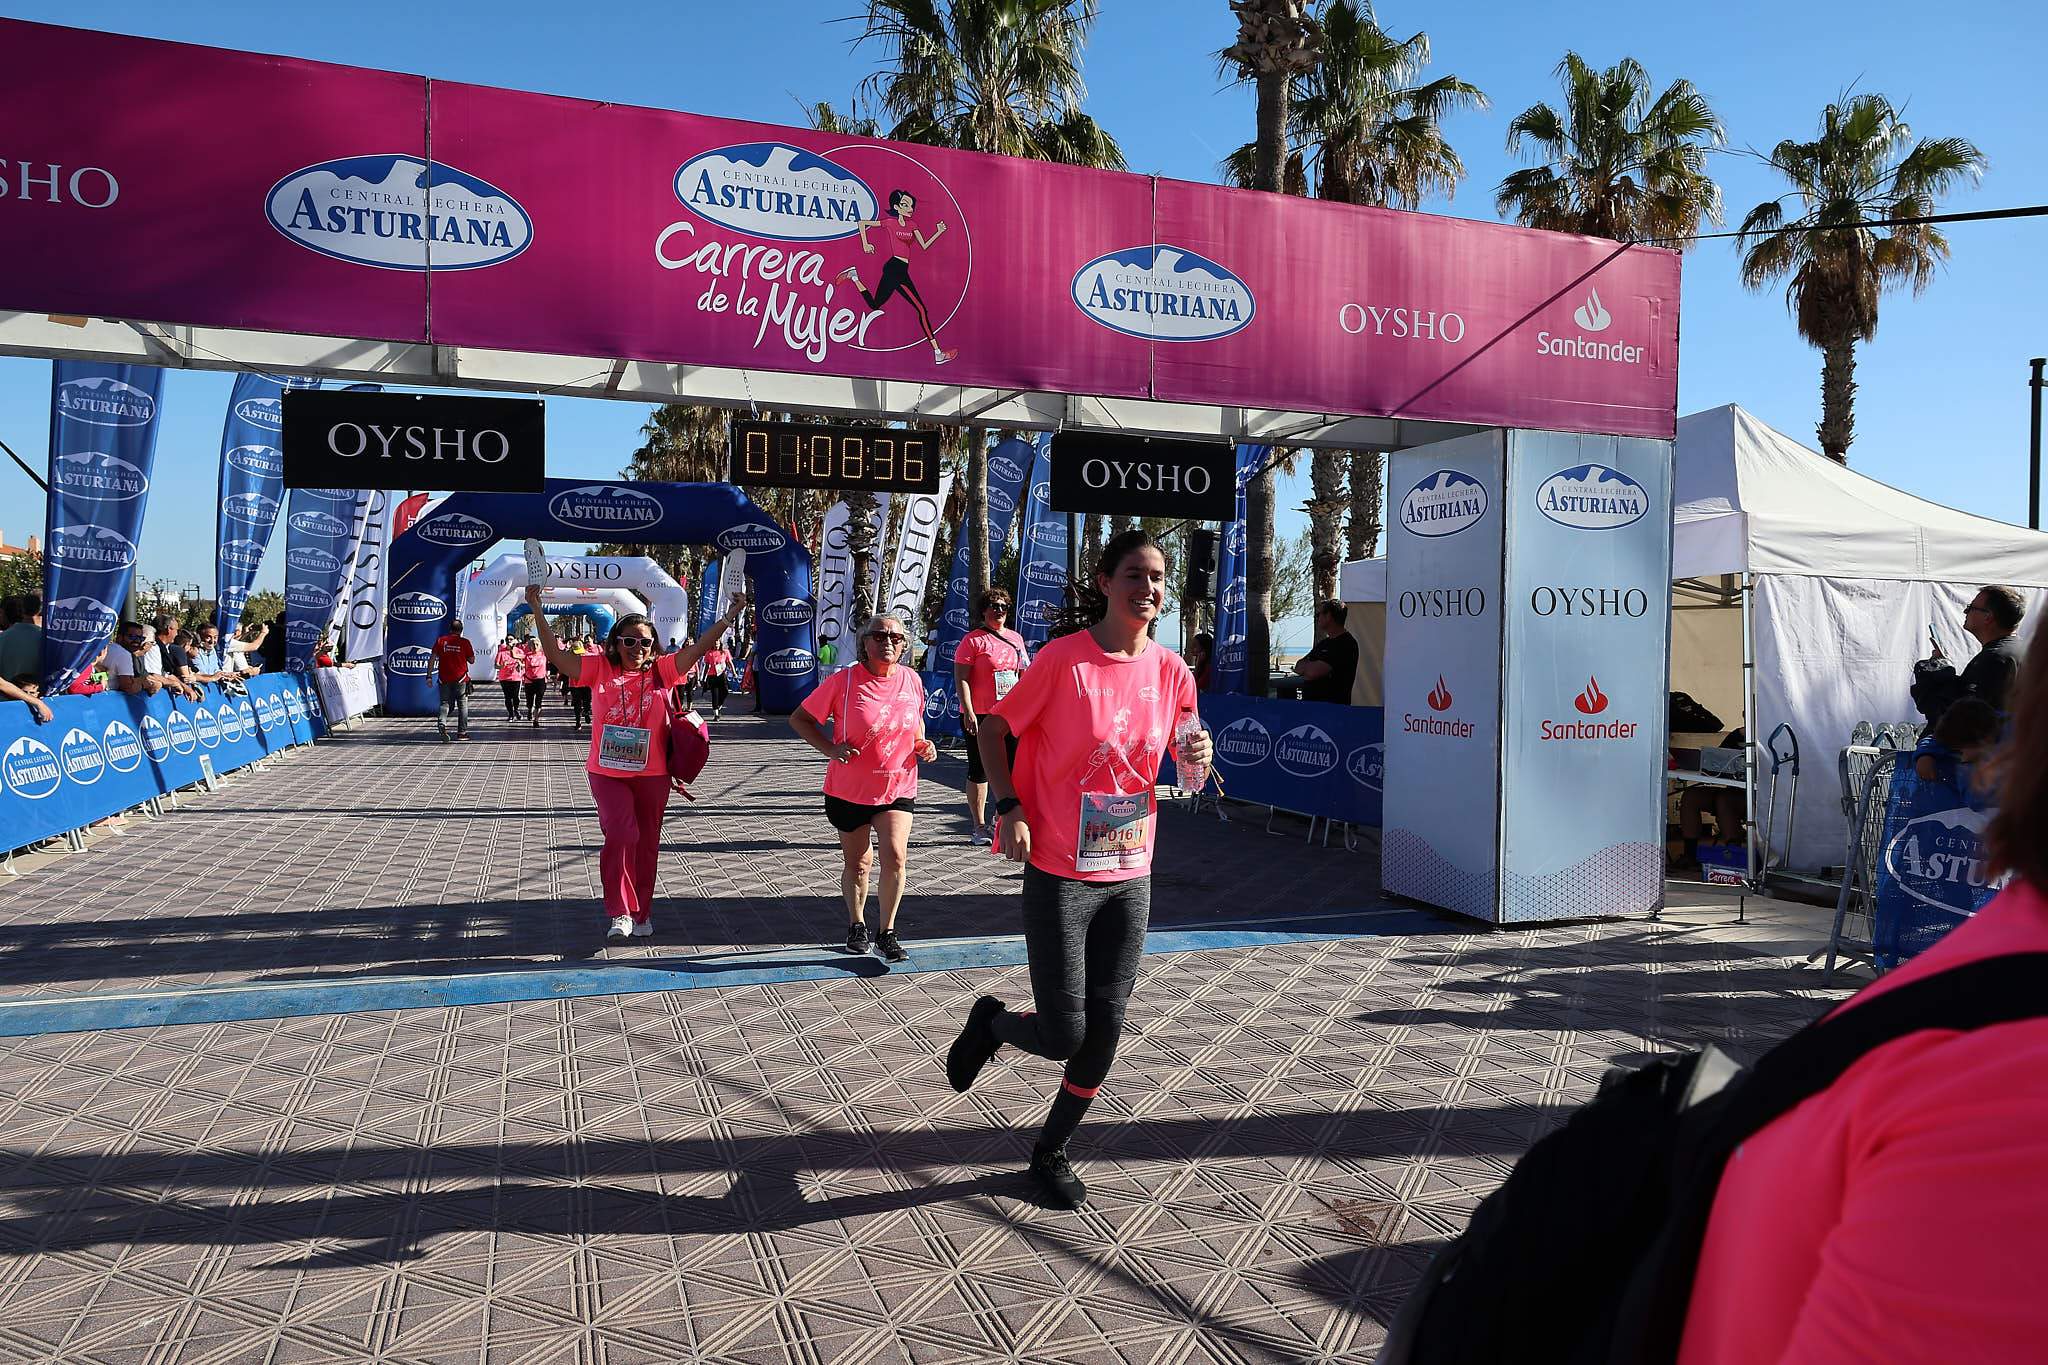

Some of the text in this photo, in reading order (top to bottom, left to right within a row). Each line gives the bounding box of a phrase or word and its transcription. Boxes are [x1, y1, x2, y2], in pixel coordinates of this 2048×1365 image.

[691, 168, 862, 223] ASTURIANA
[724, 169, 858, 196] CENTRAL LECHERA
[330, 188, 505, 215] CENTRAL LECHERA
[288, 187, 513, 248] ASTURIANA
[655, 221, 824, 286] Carrera
[1087, 273, 1241, 322] ASTURIANA
[1116, 273, 1237, 295] CENTRAL LECHERA
[697, 278, 885, 363] de la Mujer
[1339, 303, 1465, 345] OYSHO
[1537, 331, 1644, 365] Santander
[59, 390, 149, 419] ASTURIANA
[327, 421, 510, 463] OYSHO
[1081, 458, 1212, 496] OYSHO
[1561, 485, 1637, 496] CENTRAL LECHERA
[1417, 488, 1479, 503] CENTRAL LECHERA
[1544, 486, 1641, 516] ASTURIANA
[559, 497, 655, 522] ASTURIANA
[1405, 499, 1481, 525] ASTURIANA
[292, 516, 343, 535] ASTURIANA
[422, 522, 487, 539] ASTURIANA
[723, 535, 781, 547] ASTURIANA
[288, 552, 336, 571] ASTURIANA
[392, 602, 443, 615] ASTURIANA
[1400, 587, 1485, 619] OYSHO
[1531, 586, 1648, 618] OYSHO
[1404, 713, 1474, 739] Santander
[1541, 719, 1638, 741] Santander
[1219, 733, 1266, 756] ASTURIANA
[1278, 741, 1331, 768] ASTURIANA
[9, 763, 59, 786] ASTURIANA
[65, 751, 103, 773] ASTURIANA
